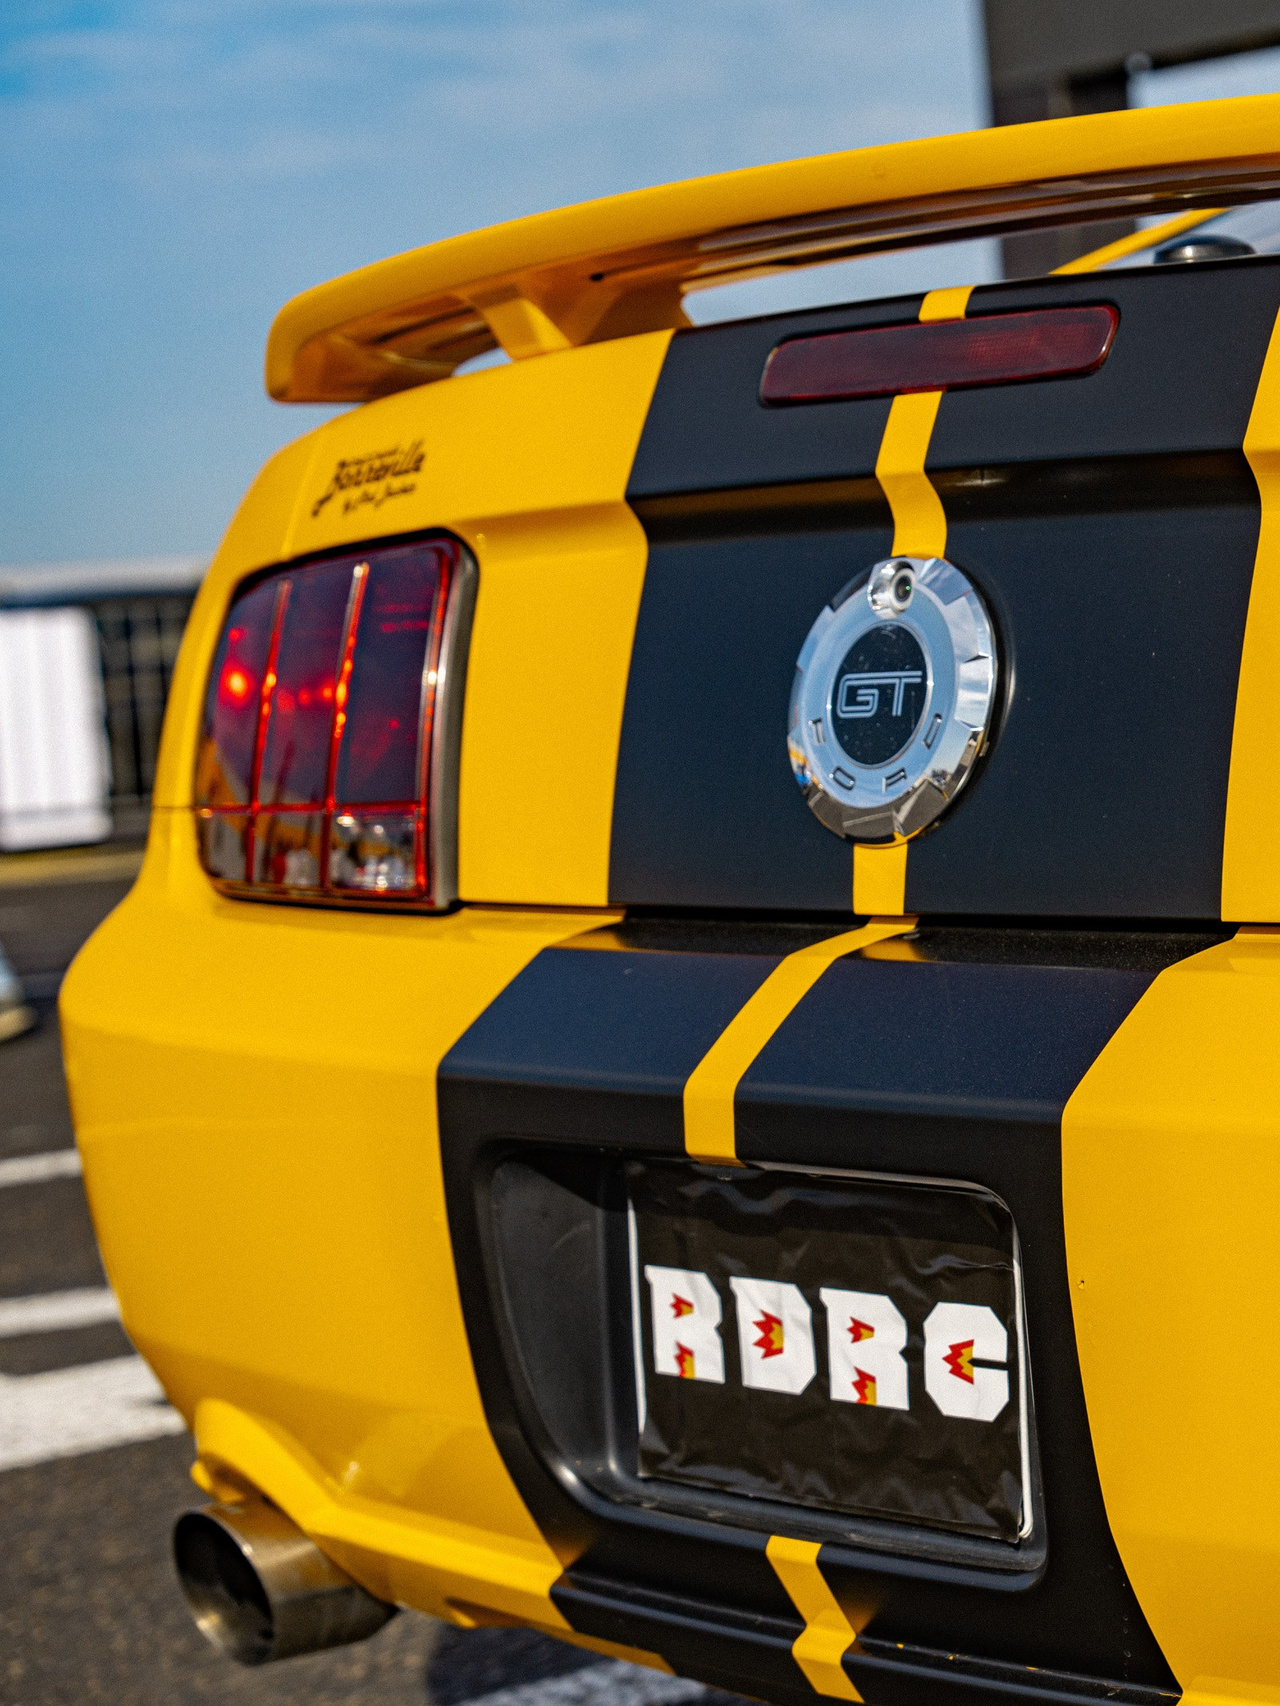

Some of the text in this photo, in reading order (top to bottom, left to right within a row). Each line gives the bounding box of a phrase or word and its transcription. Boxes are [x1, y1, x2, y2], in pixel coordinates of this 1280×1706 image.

[836, 670, 923, 719] GT
[808, 712, 943, 793] FORD
[643, 1264, 1010, 1423] RDRC
